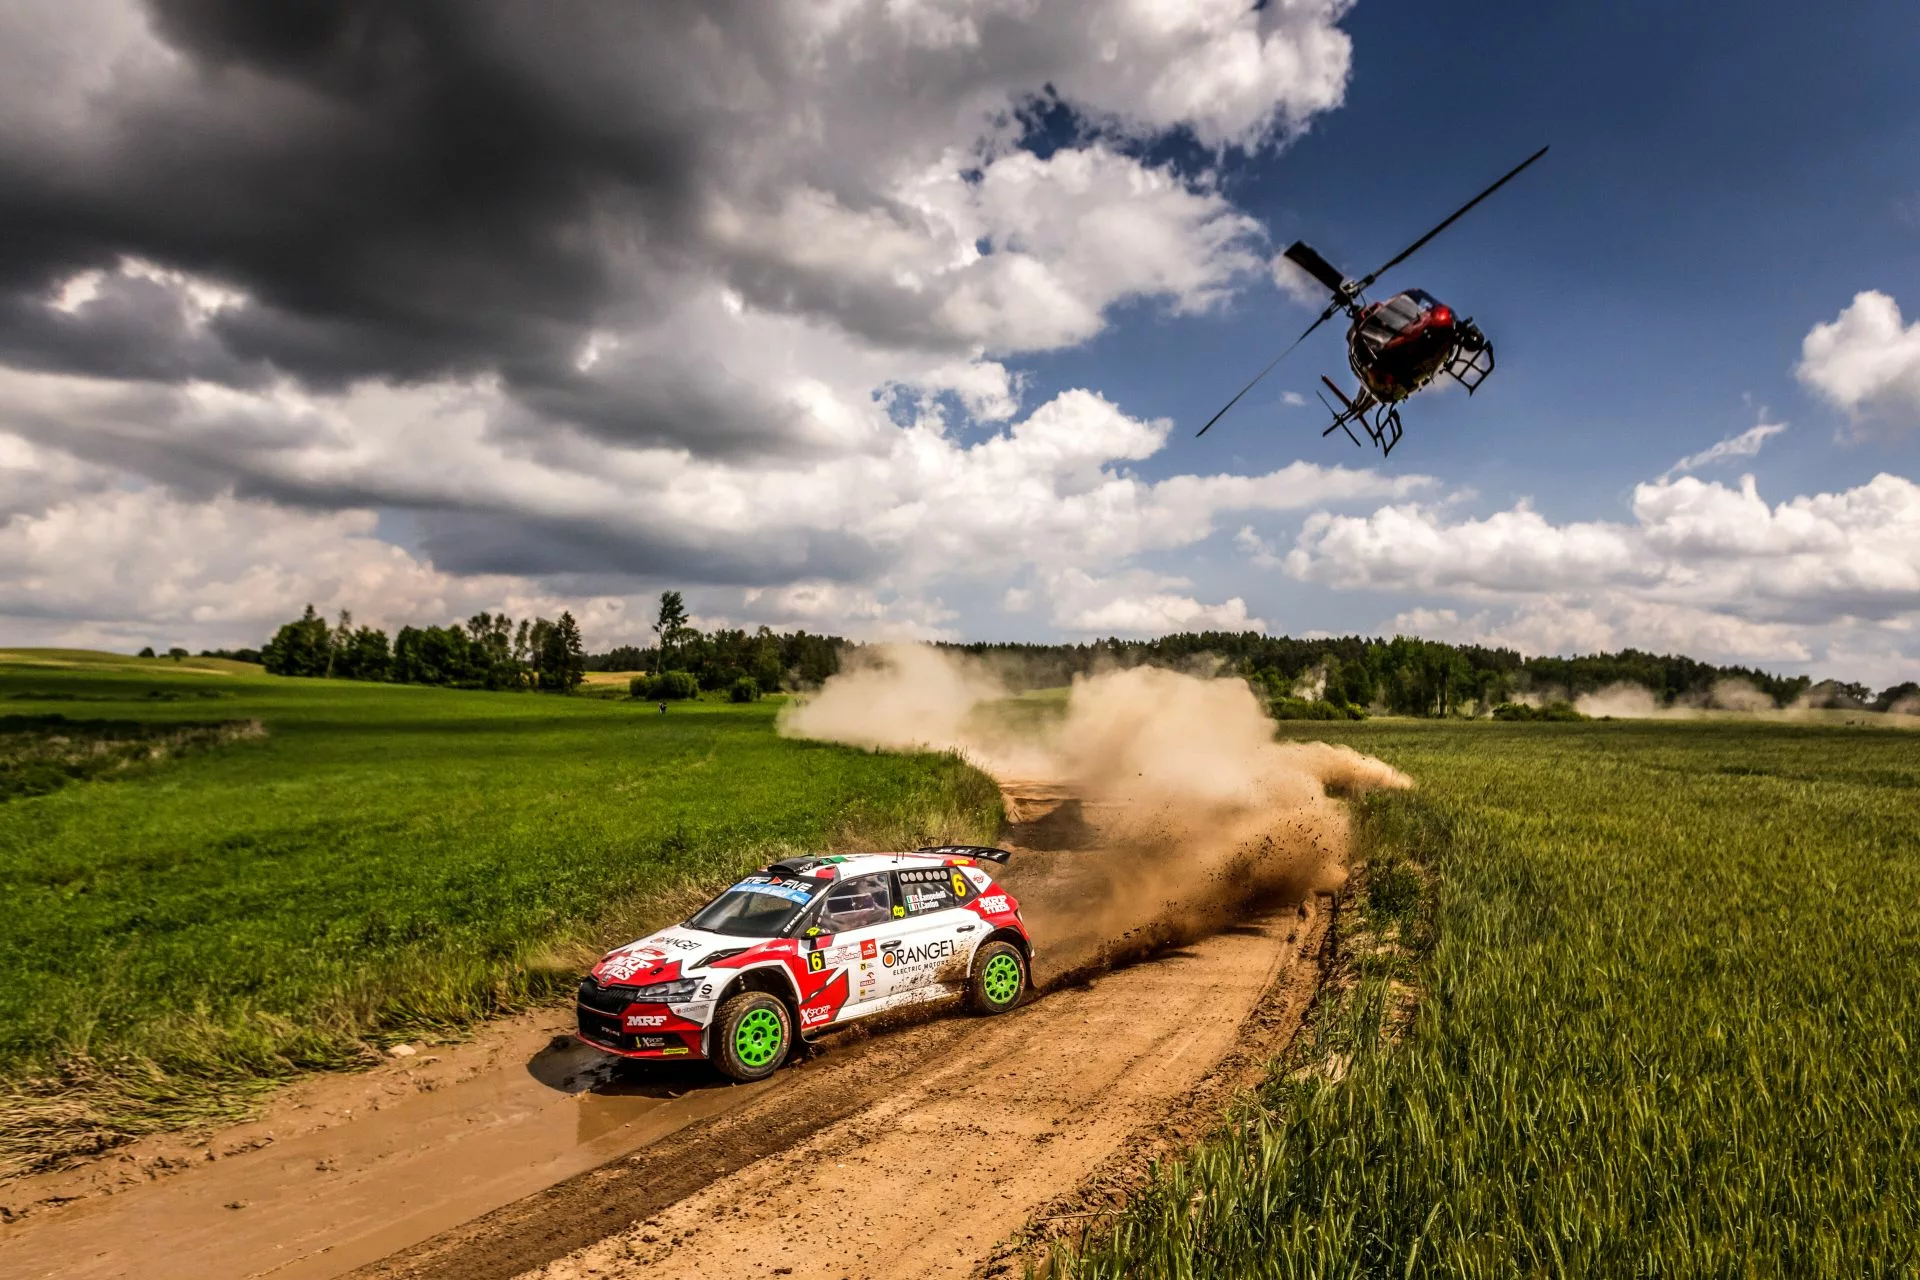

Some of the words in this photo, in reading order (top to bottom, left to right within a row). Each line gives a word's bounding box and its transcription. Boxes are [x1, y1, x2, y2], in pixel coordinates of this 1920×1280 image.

[780, 879, 813, 892] FIVE
[952, 873, 966, 897] 6
[978, 895, 1007, 907] MRF
[983, 904, 1011, 914] TYRES
[883, 939, 955, 968] ORANGE1
[811, 951, 822, 971] 6
[893, 965, 921, 975] ELECTRIC
[627, 1015, 667, 1026] MRF
